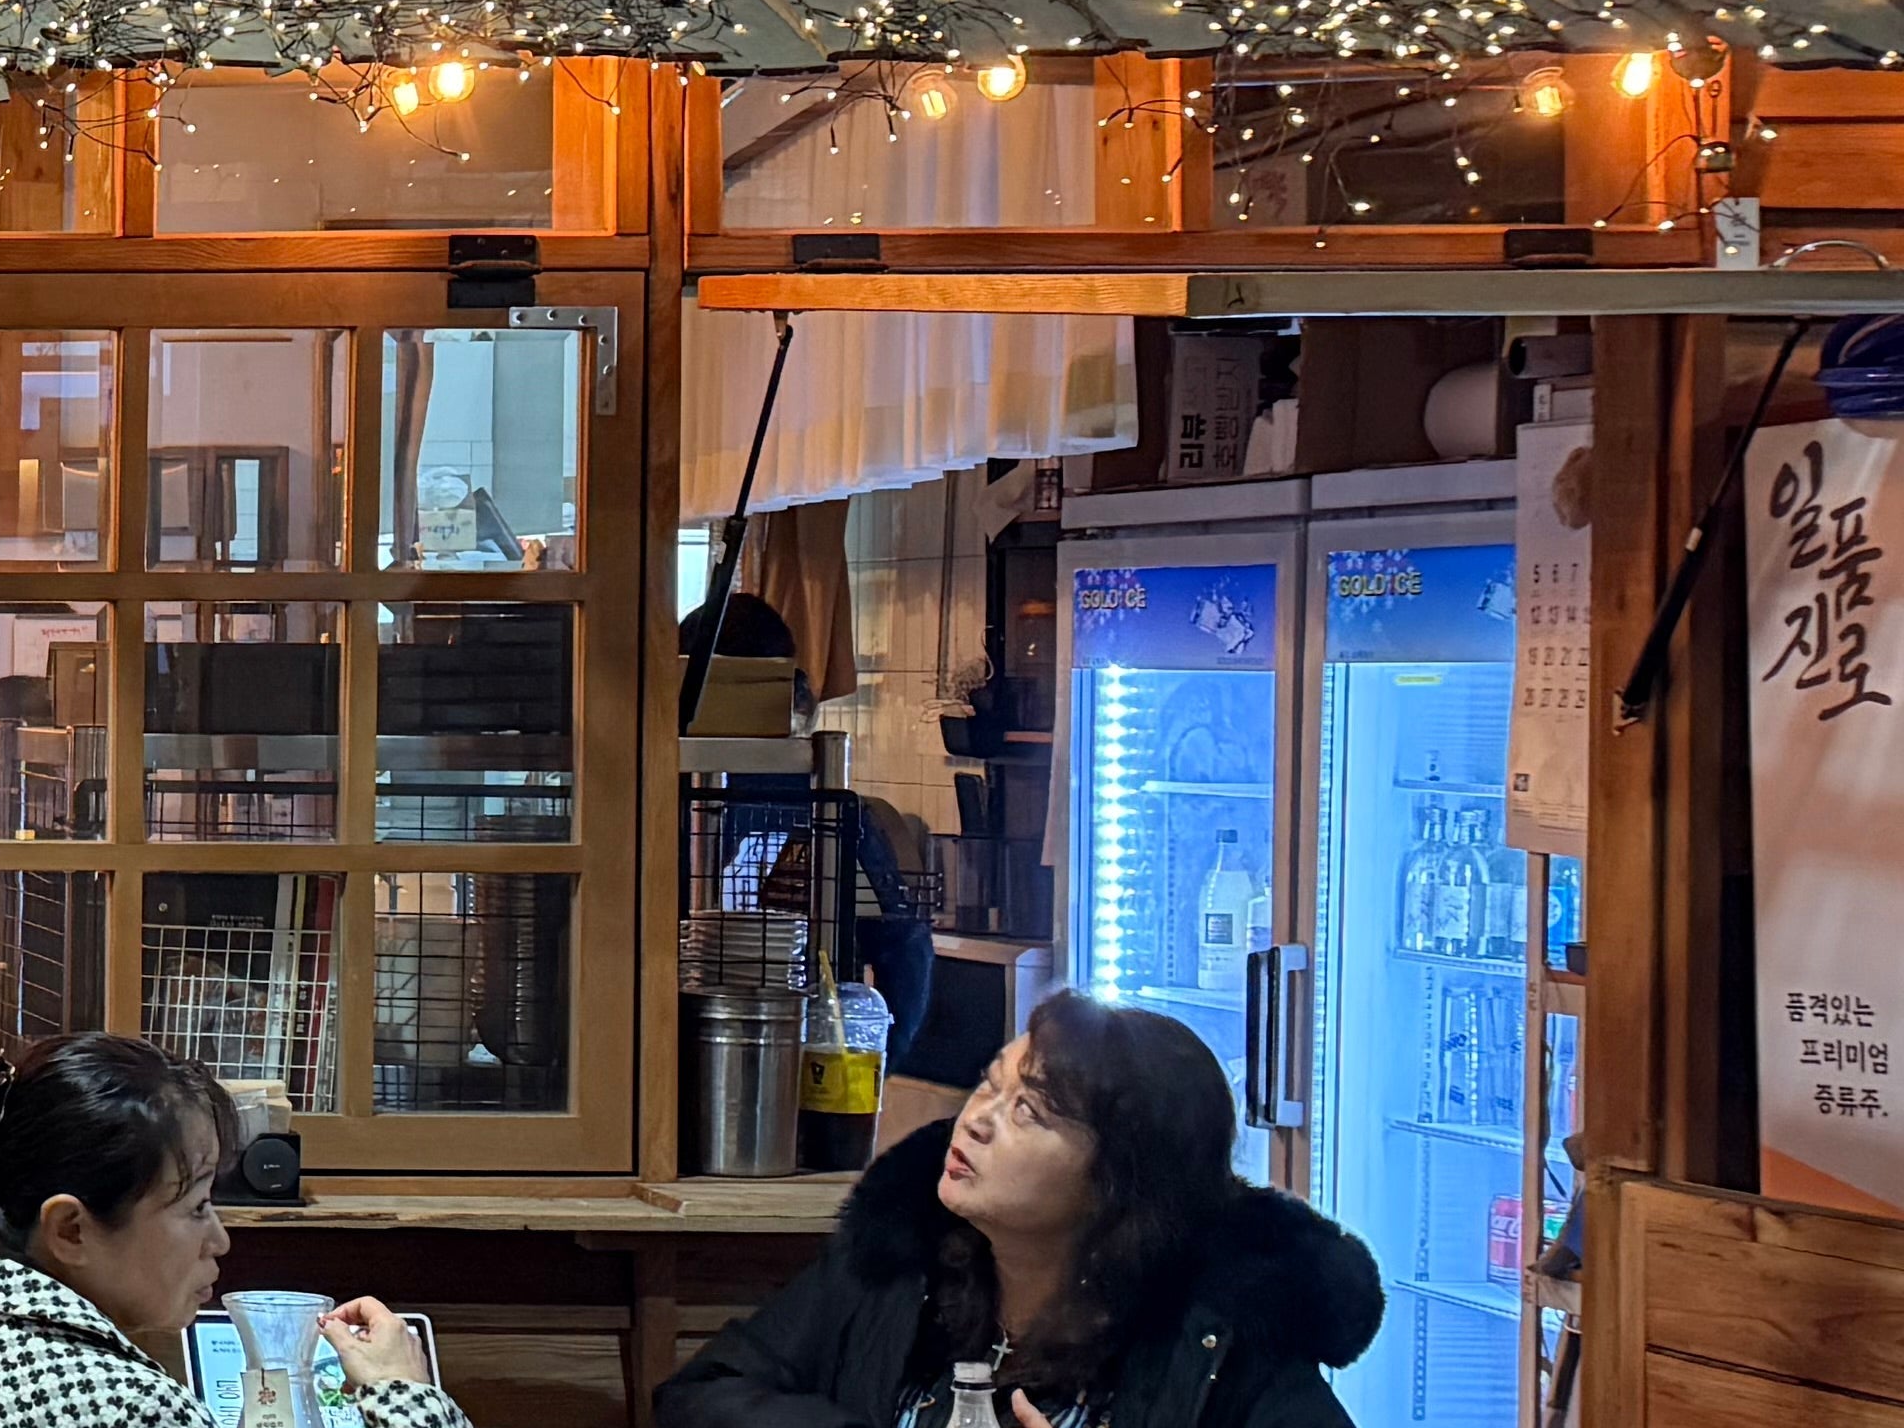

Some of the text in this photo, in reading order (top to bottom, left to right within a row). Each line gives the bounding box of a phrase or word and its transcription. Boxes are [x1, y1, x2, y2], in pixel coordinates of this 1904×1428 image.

[1768, 440, 1883, 621] 일품
[1338, 573, 1385, 597] GOLD
[1761, 592, 1893, 722] 진로
[1785, 992, 1875, 1028] 품격있는
[1799, 1038, 1889, 1075] 프리미엄
[1813, 1083, 1889, 1119] 증류주.
